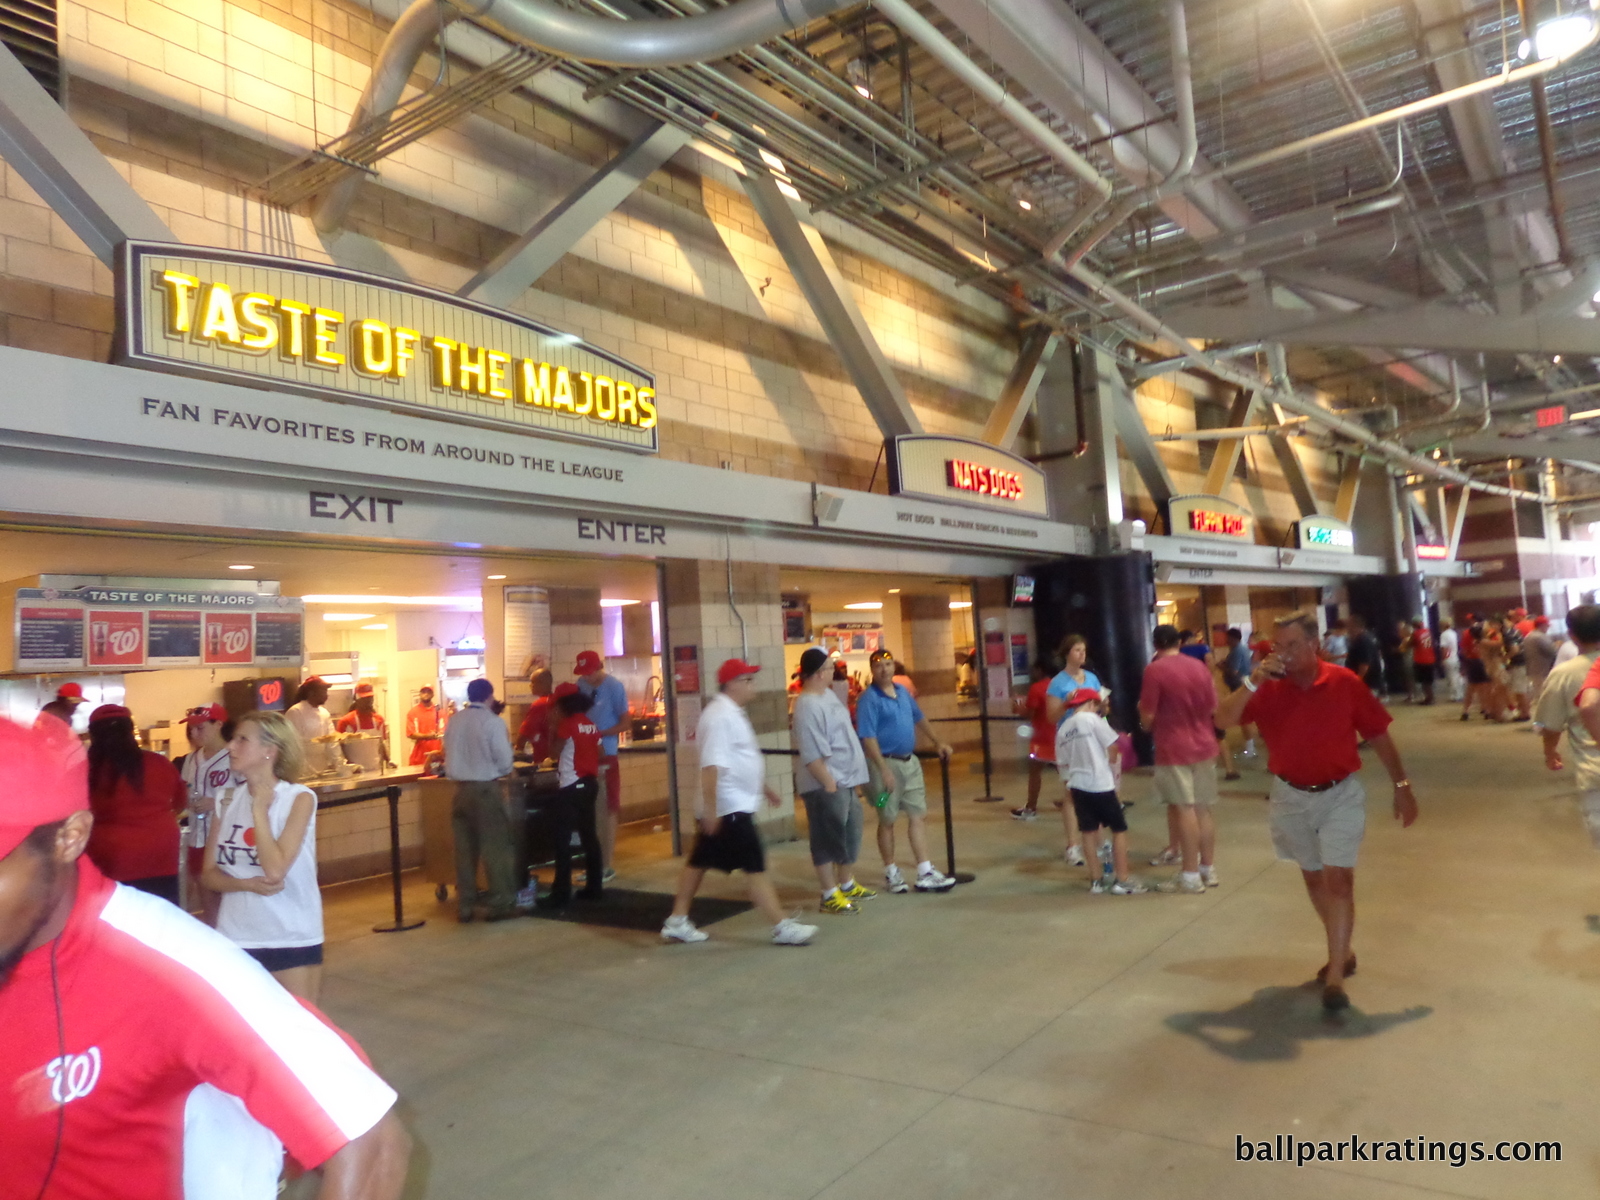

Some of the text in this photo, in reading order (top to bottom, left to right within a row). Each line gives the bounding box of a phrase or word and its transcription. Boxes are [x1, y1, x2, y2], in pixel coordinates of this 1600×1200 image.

[164, 269, 657, 428] TASTE OF THE MAJORS
[142, 397, 624, 482] FAN FAVORITES FROM AROUND THE LEAGUE
[953, 458, 1024, 501] NATS DOGS
[309, 490, 403, 524] EXIT
[577, 517, 667, 545] ENTER
[90, 591, 254, 605] TASTE OF THE MAJORS
[225, 824, 243, 845] I
